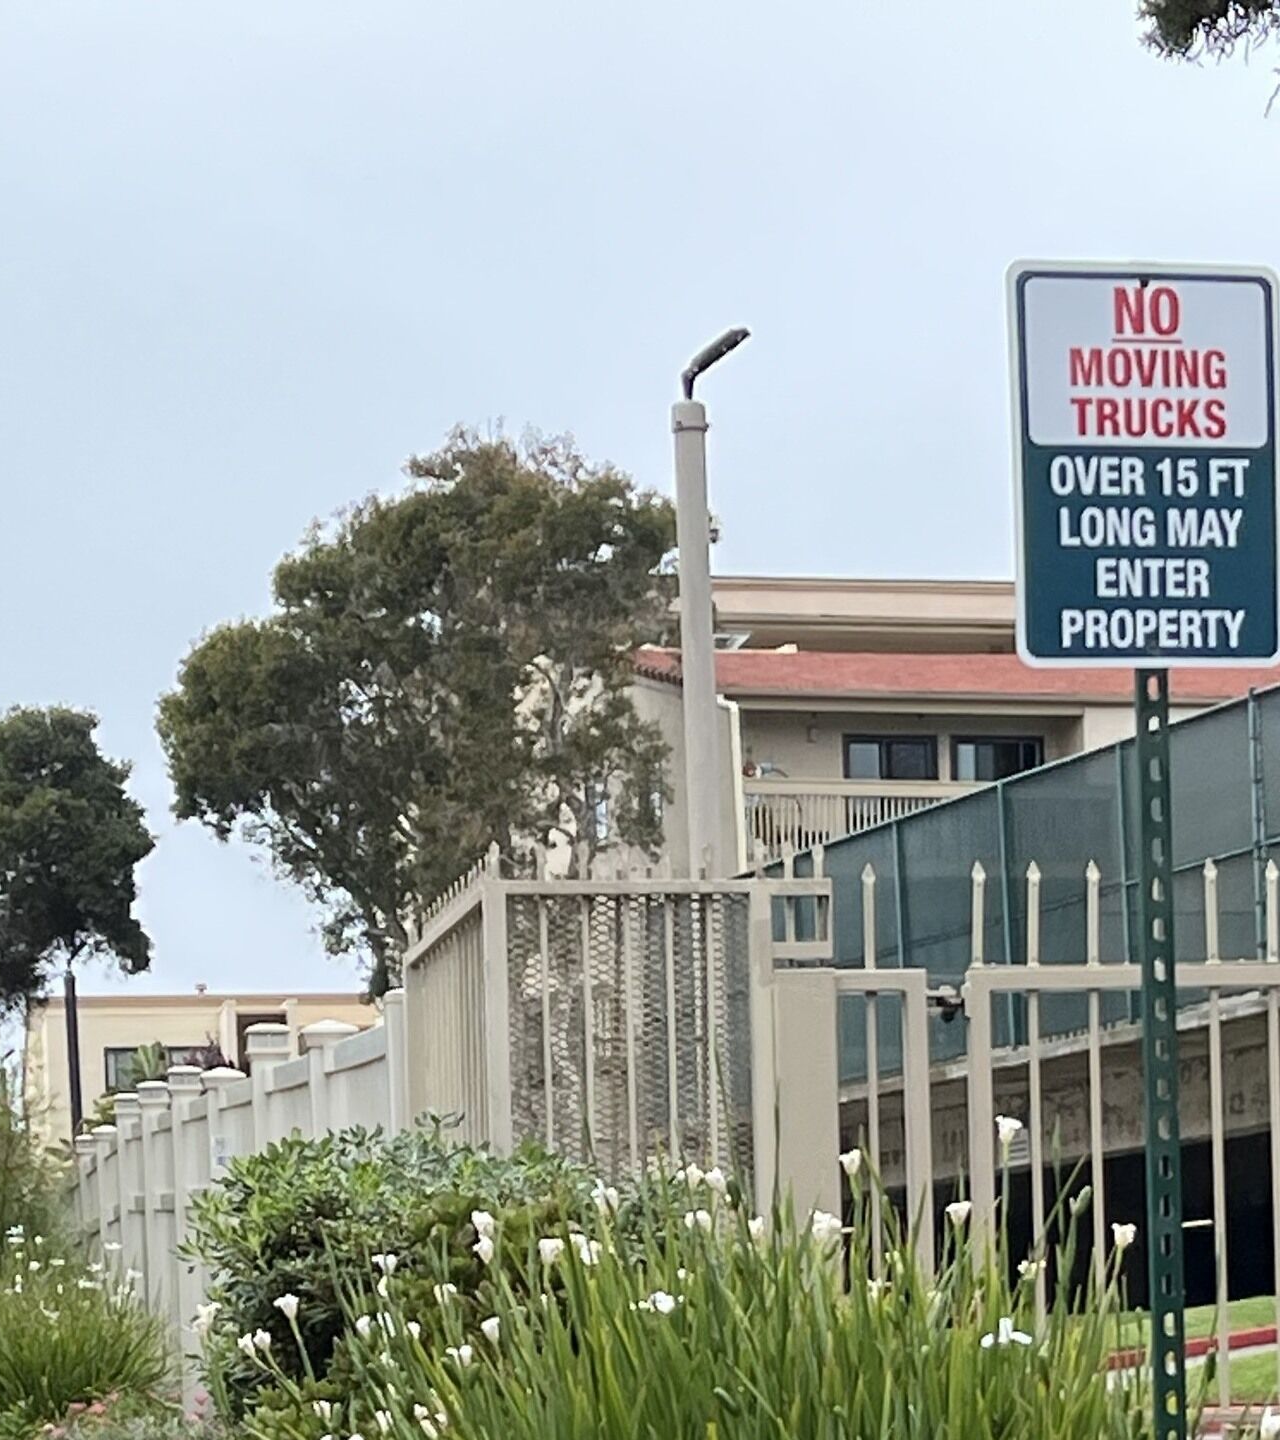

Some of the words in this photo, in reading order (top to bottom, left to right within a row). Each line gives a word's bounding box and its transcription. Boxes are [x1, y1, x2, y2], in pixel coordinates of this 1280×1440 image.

[1114, 287, 1180, 335] NO
[1070, 349, 1227, 388] MOVING
[1071, 398, 1226, 438] TRUCKS
[1050, 456, 1145, 496] OVER
[1156, 458, 1198, 496] 15
[1209, 459, 1250, 496] FT
[1060, 507, 1156, 547] LONG
[1167, 508, 1243, 547] MAY
[1096, 559, 1209, 598] ENTER
[1061, 609, 1245, 649] PROPERTY
